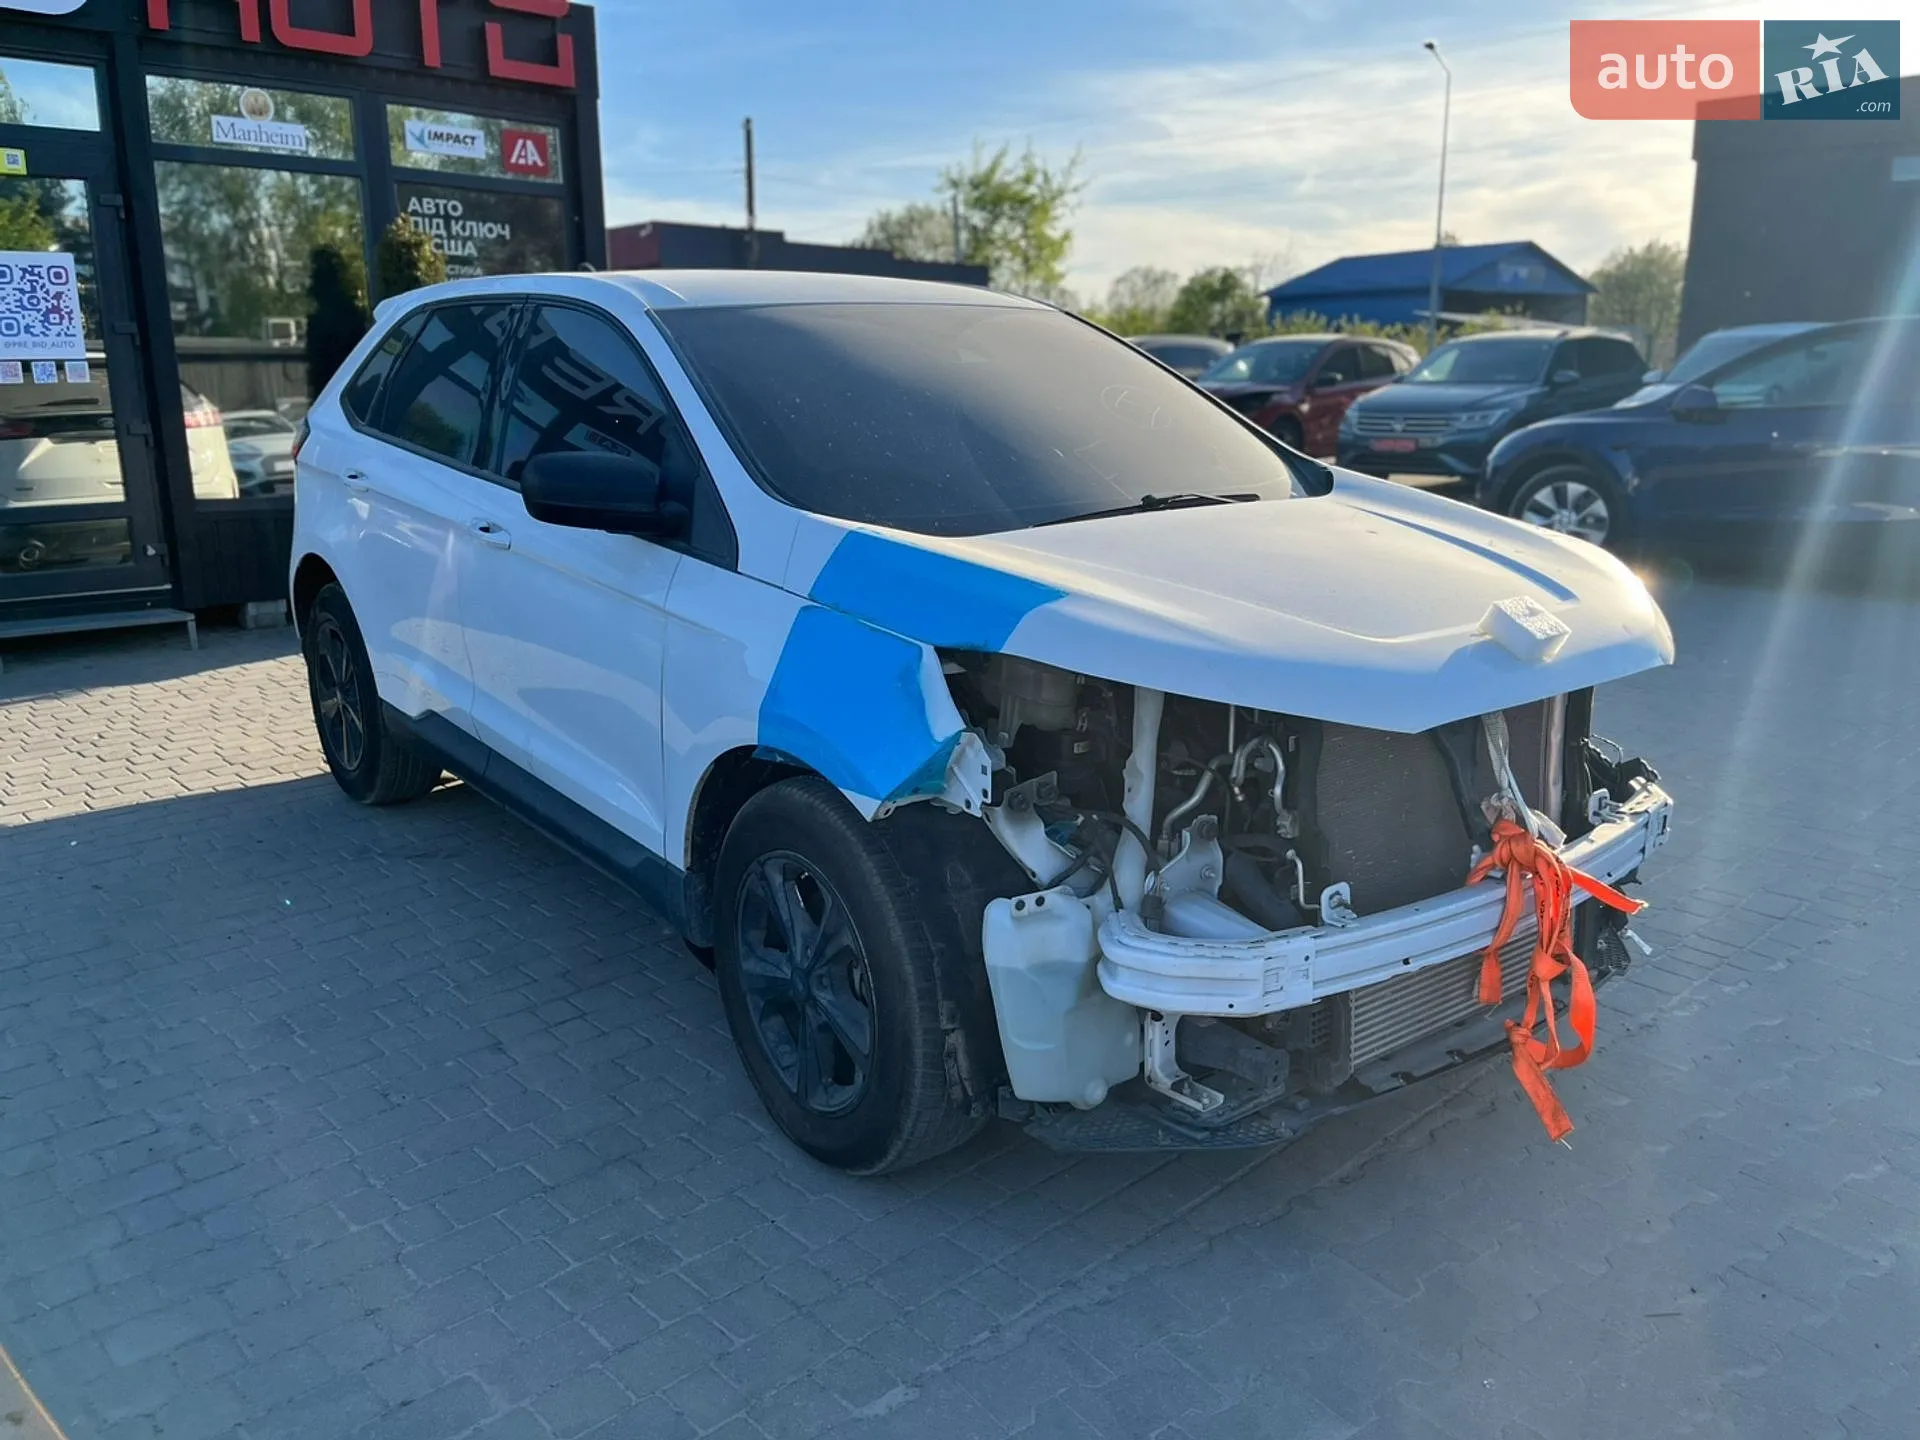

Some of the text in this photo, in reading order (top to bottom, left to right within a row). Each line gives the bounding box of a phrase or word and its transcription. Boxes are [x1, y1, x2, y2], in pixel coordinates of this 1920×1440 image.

[216, 121, 304, 148] Manheim
[428, 130, 476, 146] IMPACT
[407, 196, 463, 217] АВТО
[451, 220, 511, 241] КЛЮЧ
[431, 238, 478, 257] США
